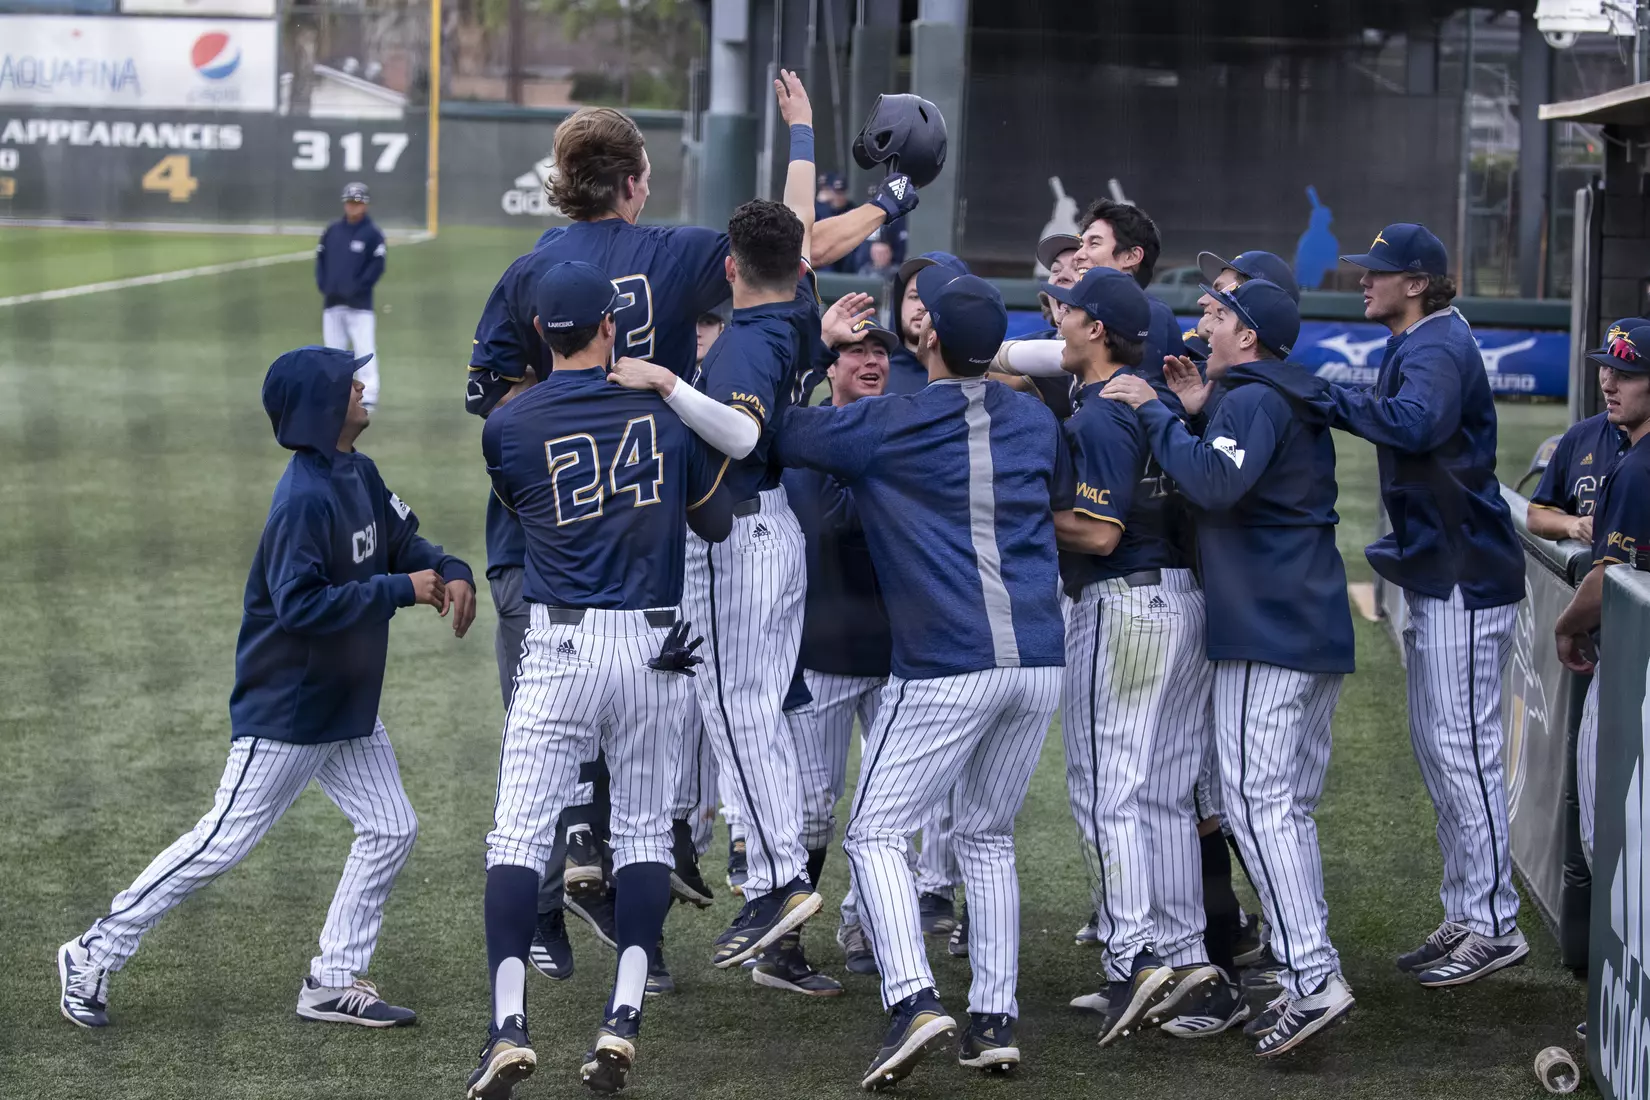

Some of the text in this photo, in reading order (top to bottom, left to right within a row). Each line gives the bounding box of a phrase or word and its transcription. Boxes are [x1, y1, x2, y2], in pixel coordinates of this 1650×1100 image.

[0, 55, 143, 96] AQUAFINA
[1, 118, 243, 150] APPEARANCES
[292, 130, 410, 173] 317
[141, 154, 199, 202] 4
[897, 175, 908, 201] adidas
[1314, 361, 1380, 384] MIZU
[544, 413, 664, 527] 24
[1076, 481, 1111, 506] WAC
[556, 647, 577, 656] adidas
[1600, 942, 1650, 1100] adida
